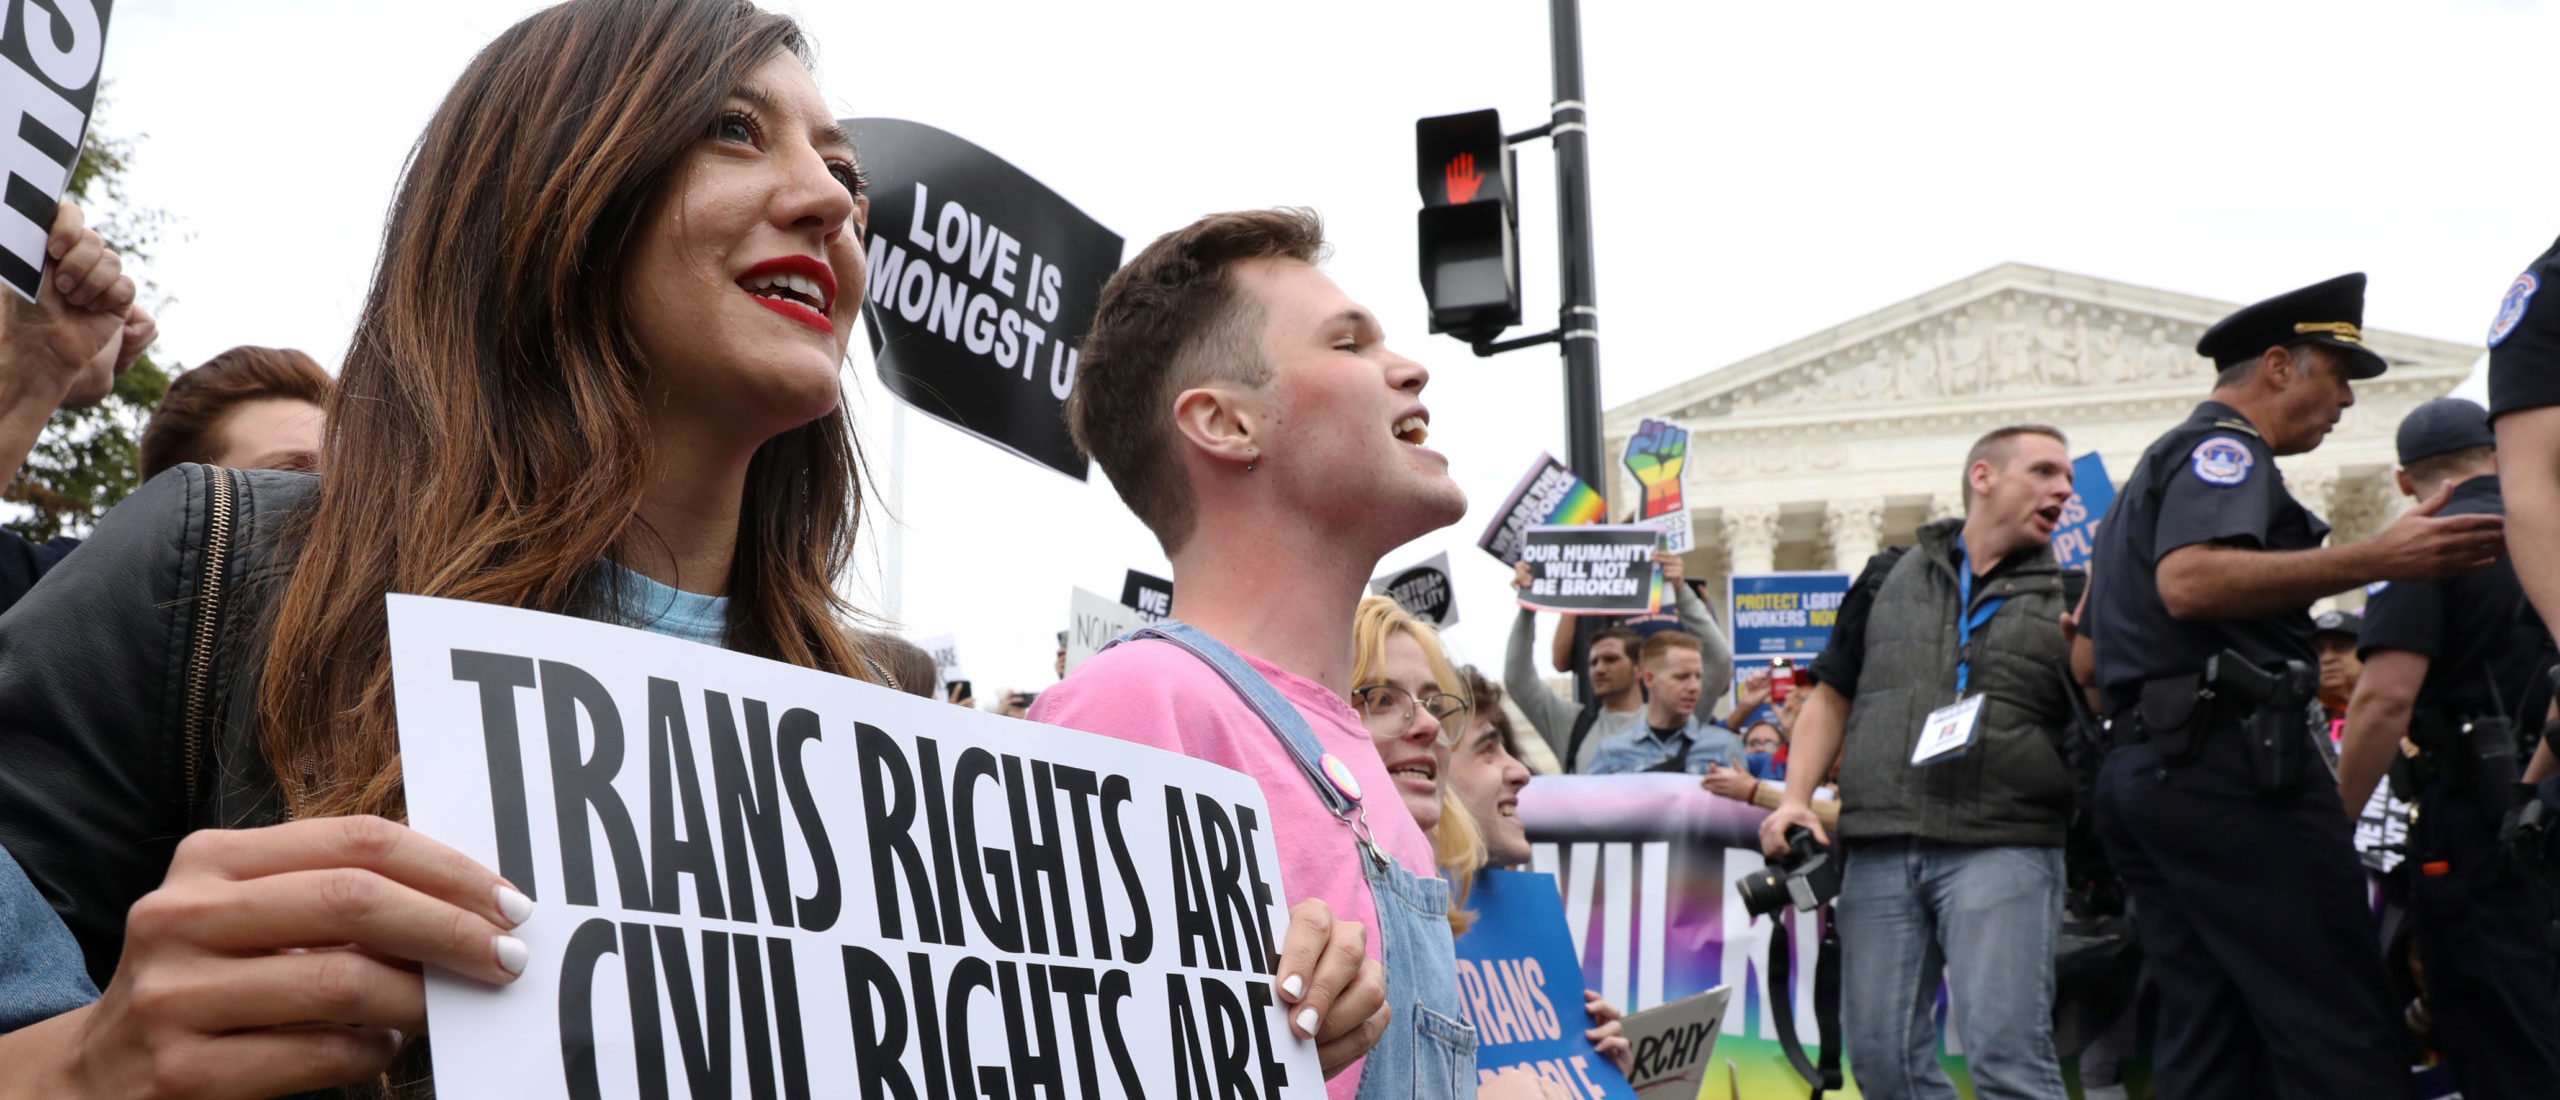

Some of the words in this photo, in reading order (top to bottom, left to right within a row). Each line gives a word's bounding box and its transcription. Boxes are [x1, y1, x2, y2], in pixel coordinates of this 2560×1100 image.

[909, 181, 1021, 298] LOVE
[1026, 253, 1062, 323] IS
[866, 233, 1046, 381] MONGST
[1050, 339, 1078, 400] U
[1523, 545, 1560, 562] OUR
[1563, 544, 1656, 562] HUMANITY
[1544, 562, 1588, 578] WILL
[1592, 562, 1630, 578] NOT
[1138, 586, 1170, 616] WE
[1532, 578, 1556, 595] BE
[1560, 578, 1638, 595] BROKEN
[1735, 593, 1798, 610] PROTECT
[1736, 610, 1807, 628] WORKERS
[450, 648, 841, 933] TRANS
[853, 720, 1154, 965] RIGHTS
[1164, 785, 1279, 975] ARE
[842, 945, 1145, 1100] RIGHTS
[1166, 974, 1289, 1100] ARE
[1456, 957, 1562, 1047] TRANS
[1629, 1017, 1716, 1082] RCHY
